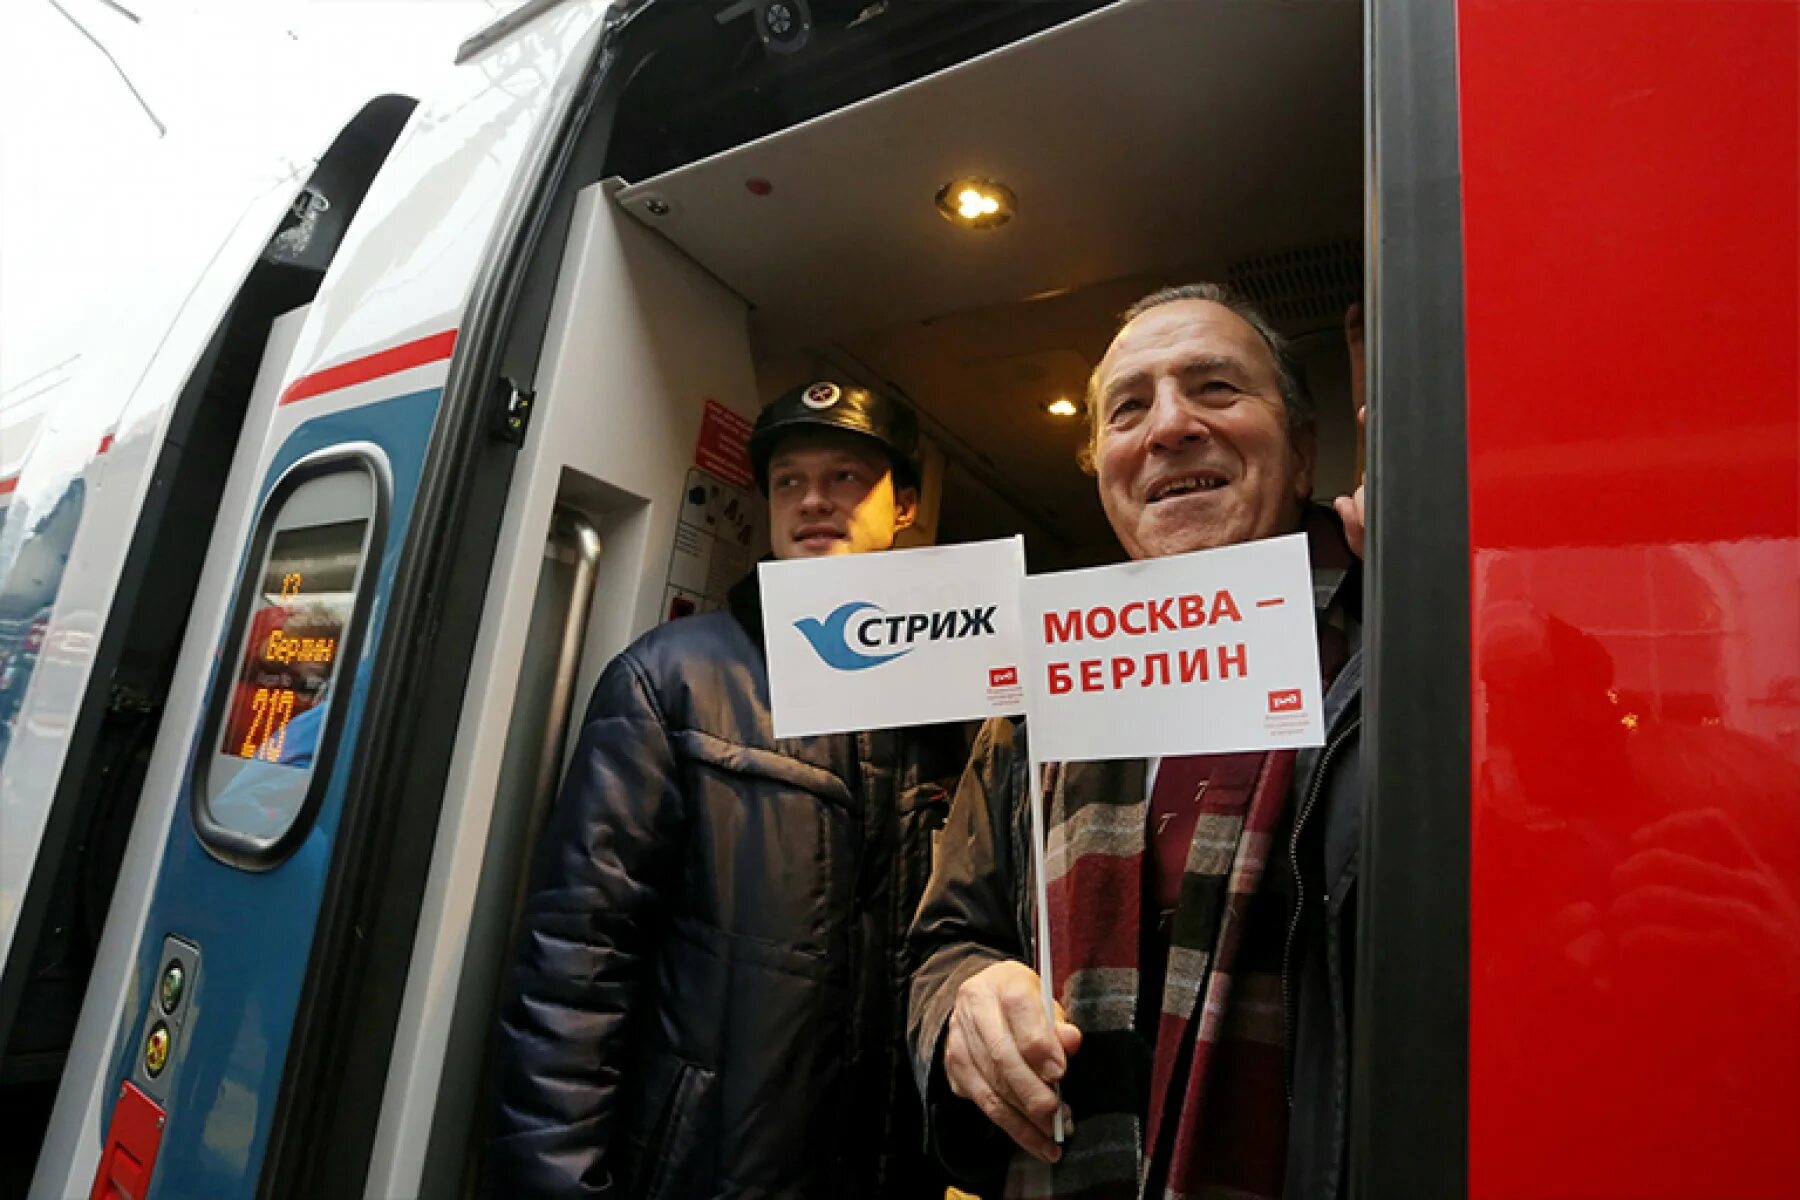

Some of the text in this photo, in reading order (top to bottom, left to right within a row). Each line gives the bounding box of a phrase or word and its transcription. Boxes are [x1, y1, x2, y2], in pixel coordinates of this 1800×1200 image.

[857, 605, 997, 647] СТРИЖ
[1044, 590, 1242, 643] МОСКВА
[266, 630, 334, 664] Берлин
[1045, 644, 1248, 694] БЕРЛИН
[241, 688, 294, 762] 213
